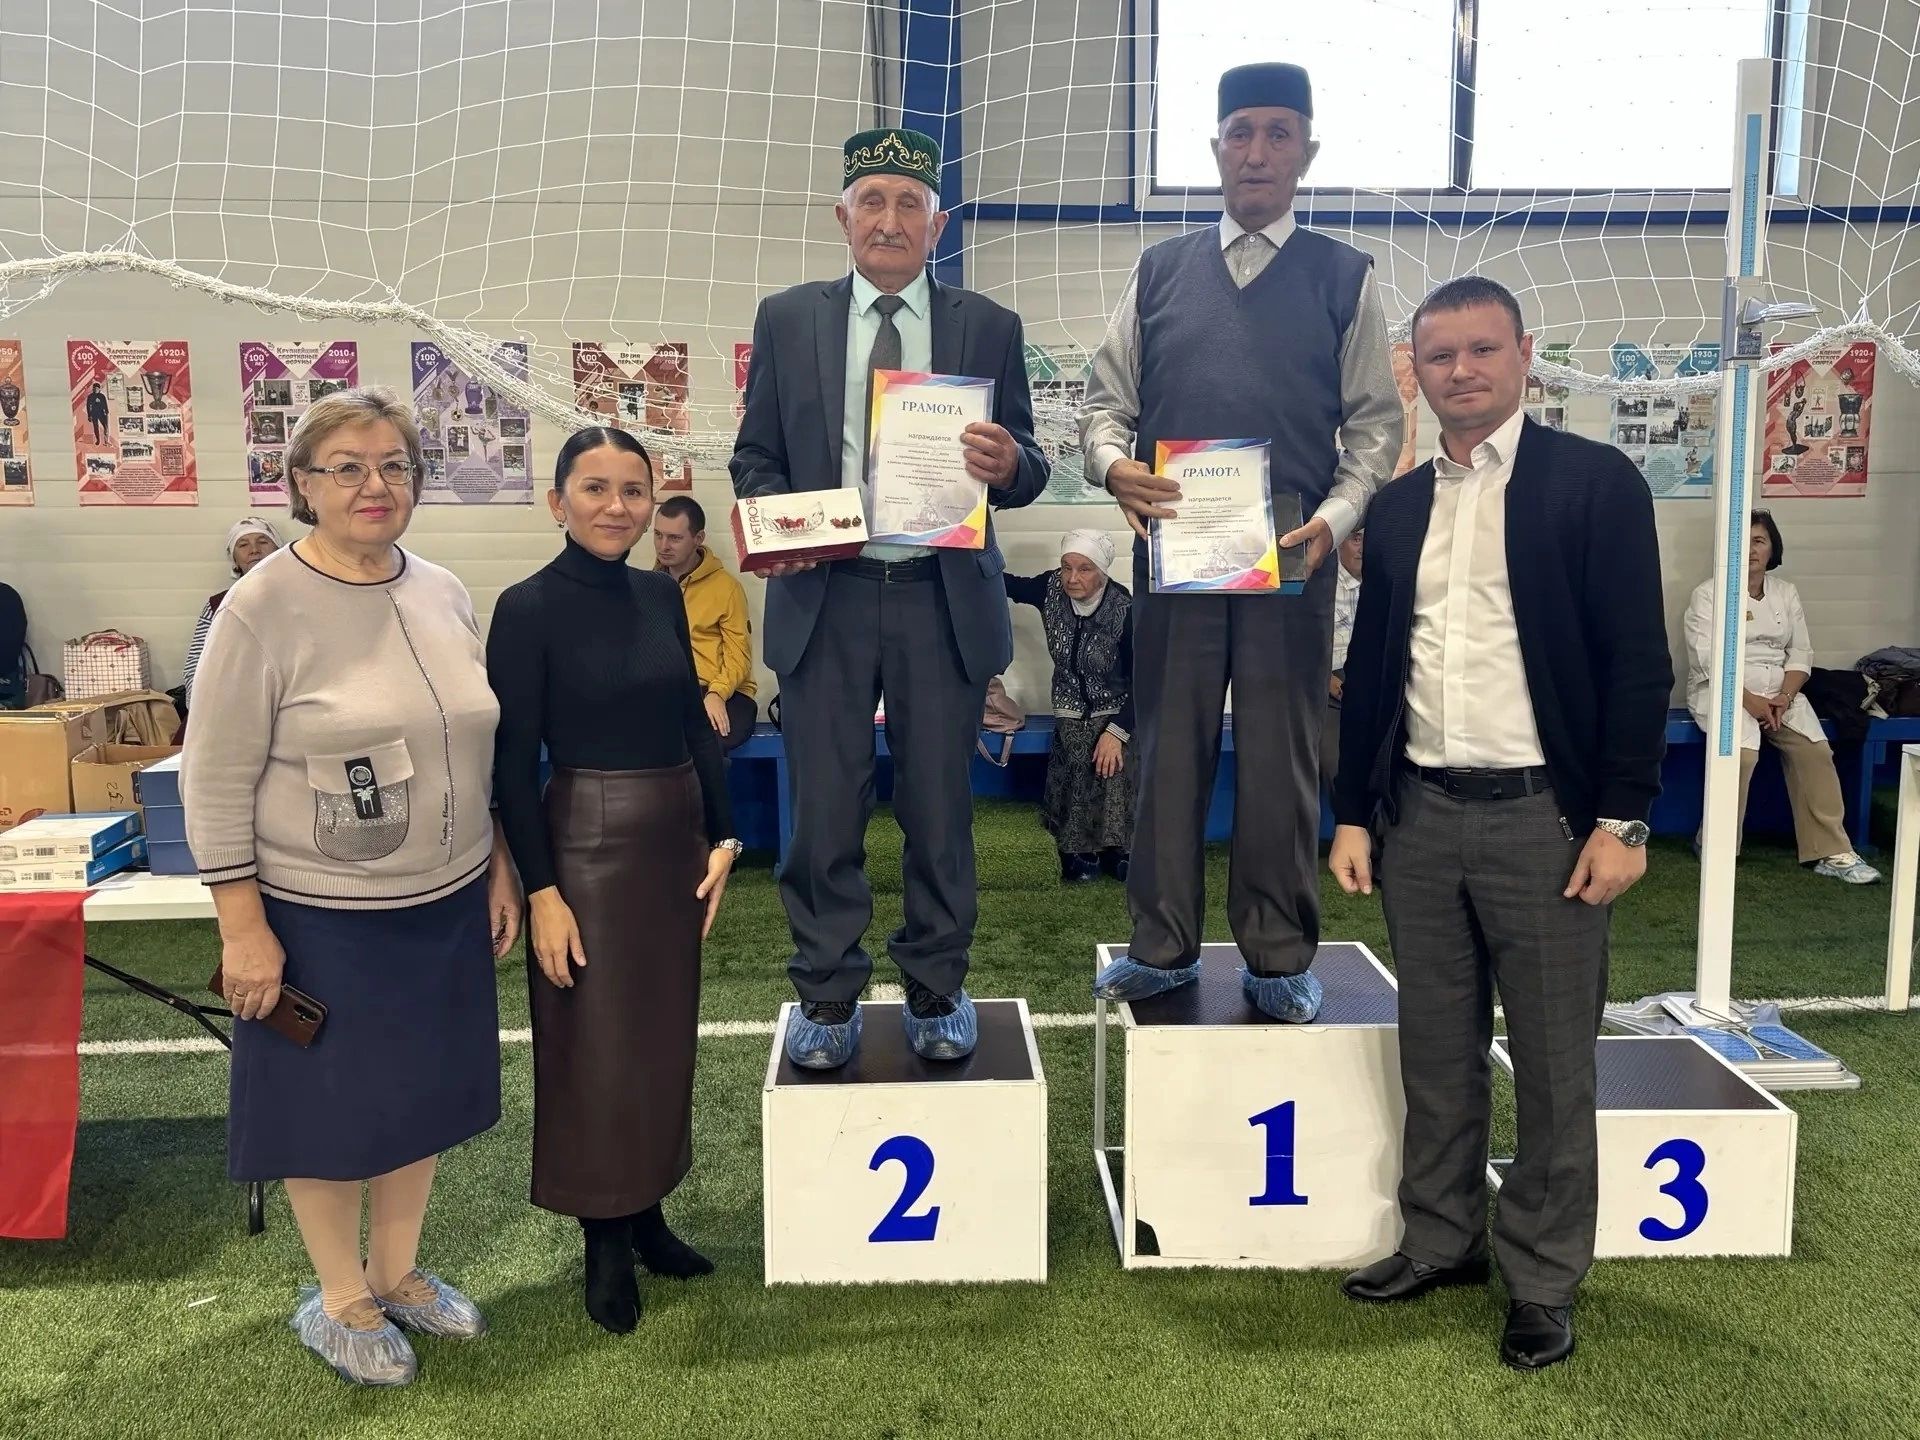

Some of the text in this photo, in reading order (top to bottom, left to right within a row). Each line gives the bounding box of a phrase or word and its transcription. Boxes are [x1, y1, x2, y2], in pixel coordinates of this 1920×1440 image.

[249, 354, 265, 362] 100
[420, 353, 436, 361] 100
[902, 400, 963, 416] ГРАМОТА
[908, 434, 951, 442] награждается
[1183, 467, 1241, 477] ГРАМОТА
[748, 506, 762, 541] VETRO
[1250, 1102, 1307, 1206] 1
[868, 1134, 940, 1243] 2
[1639, 1138, 1709, 1242] 3
